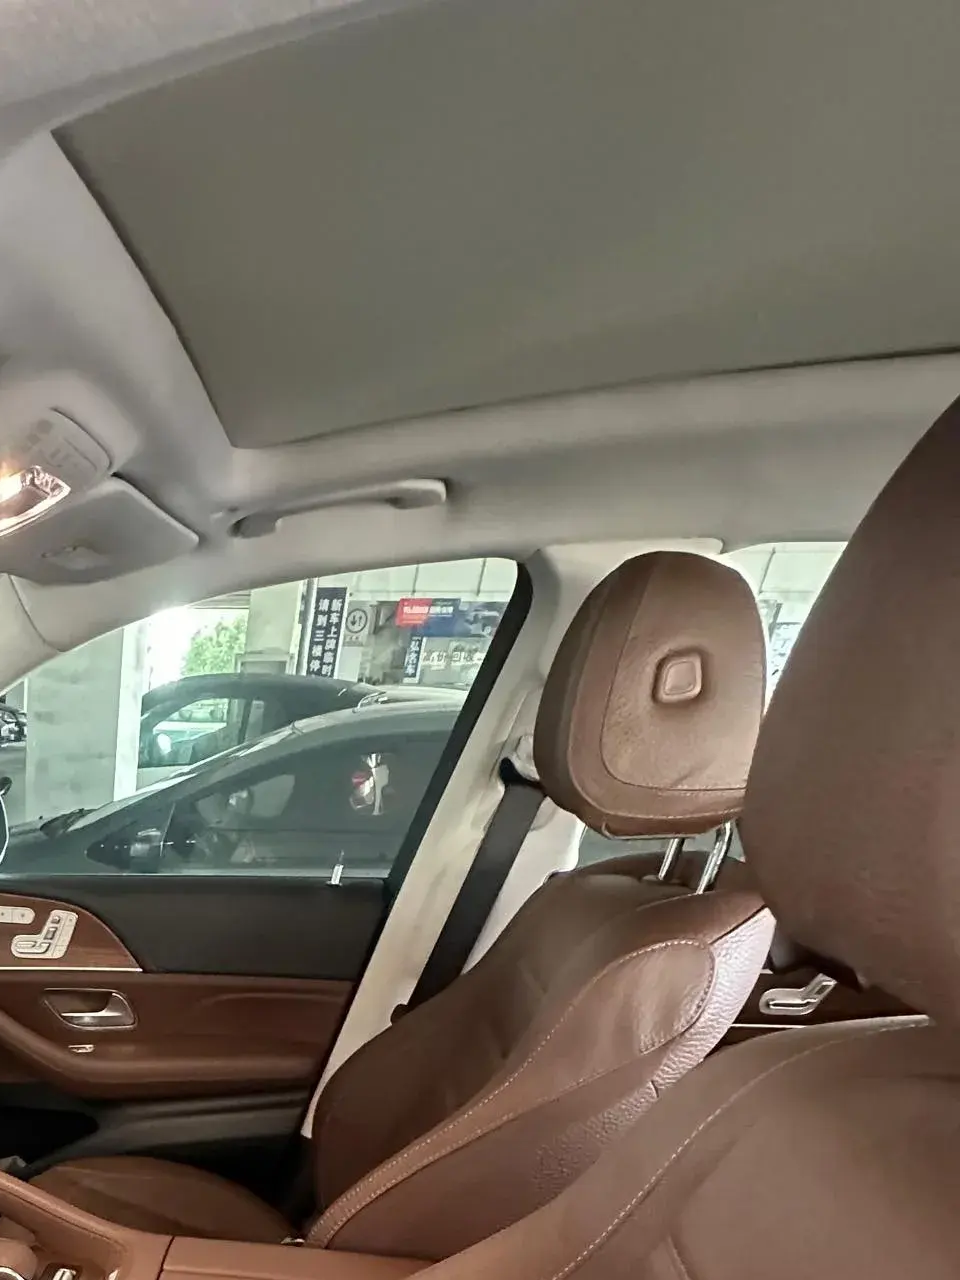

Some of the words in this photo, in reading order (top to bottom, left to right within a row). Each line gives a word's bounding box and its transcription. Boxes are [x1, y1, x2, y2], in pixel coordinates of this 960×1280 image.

[309, 598, 330, 677] 请到三楼停
